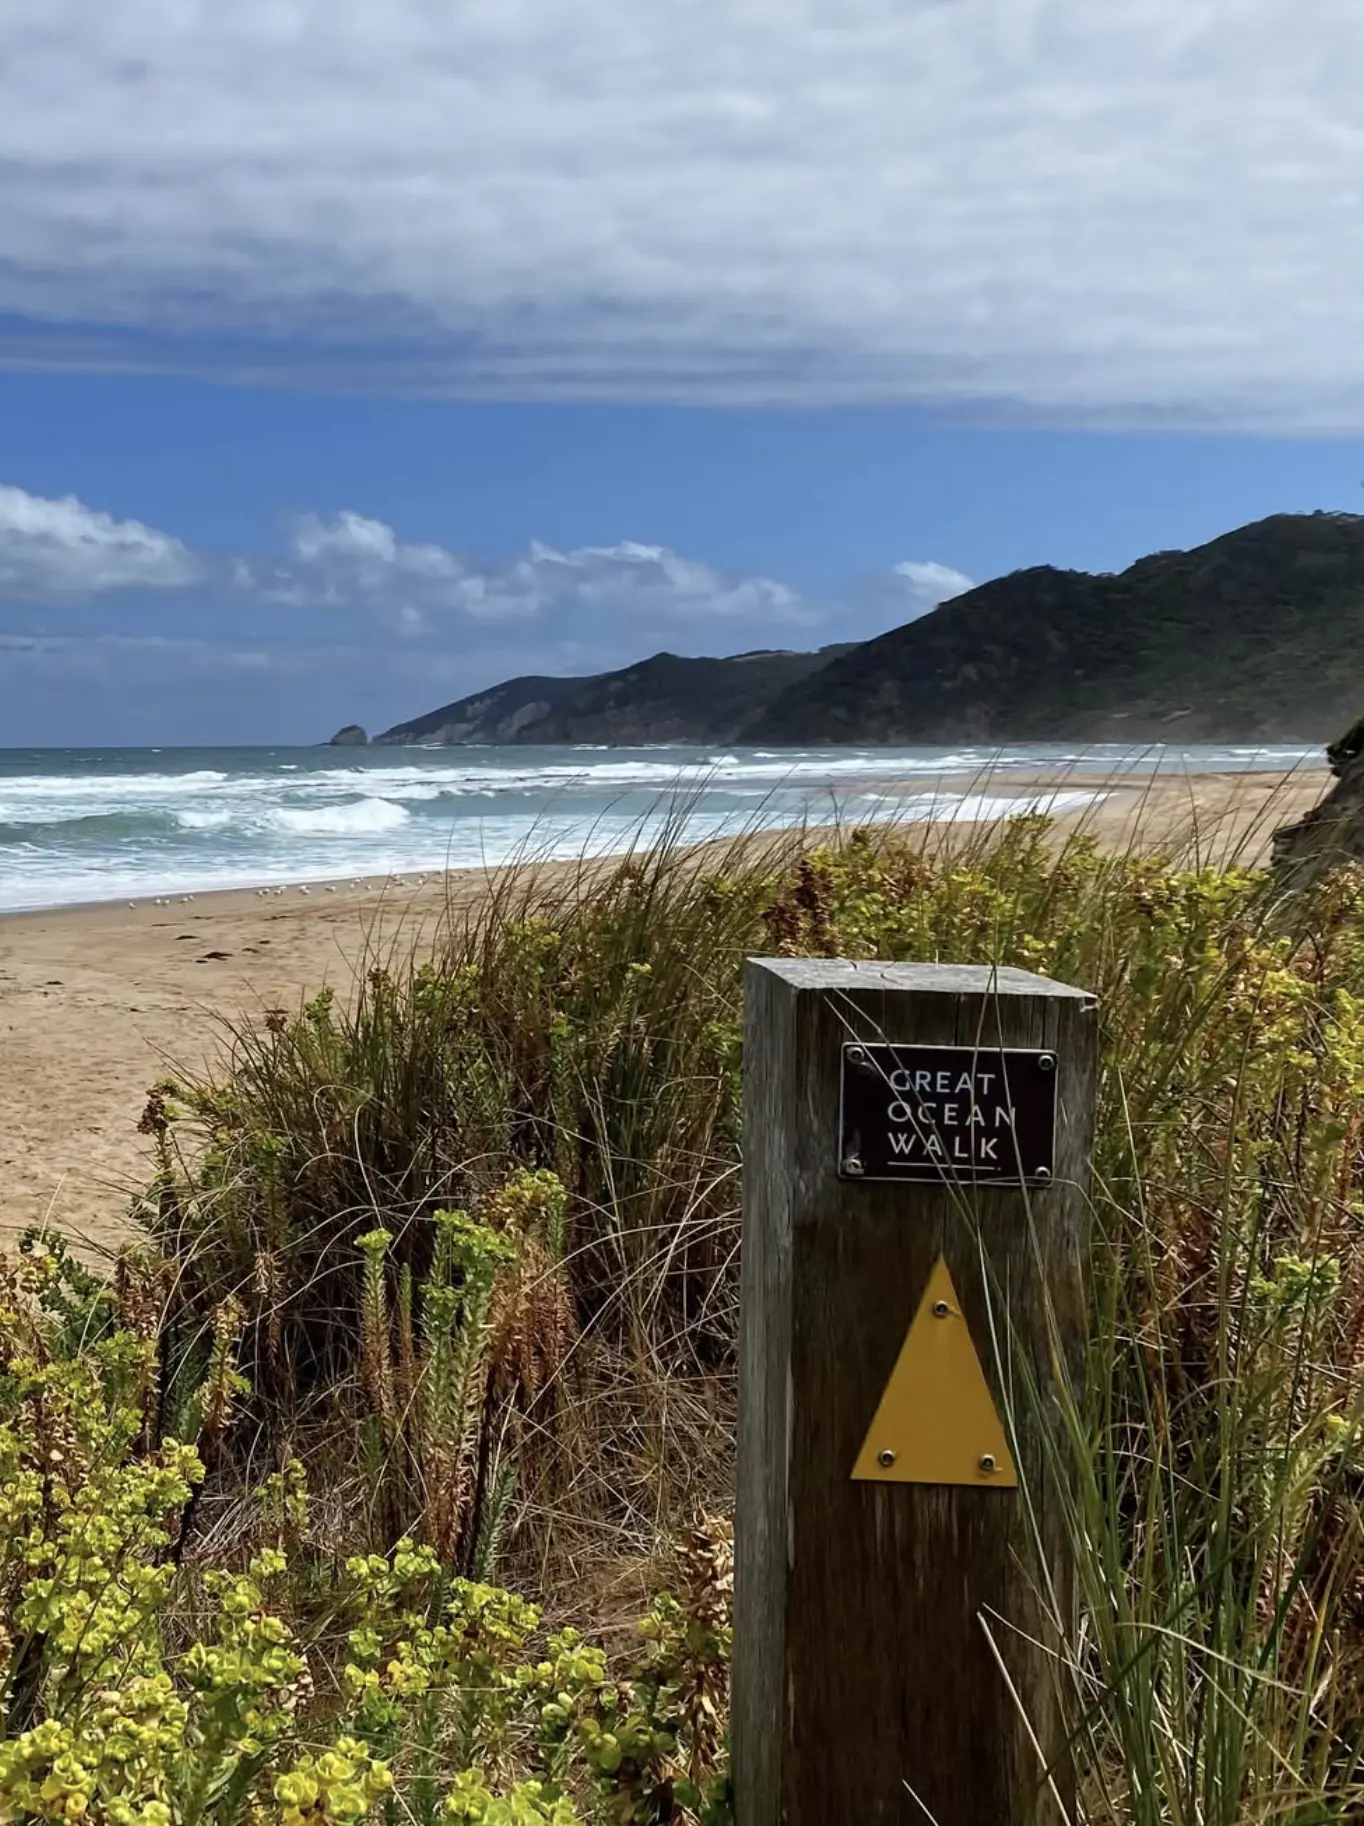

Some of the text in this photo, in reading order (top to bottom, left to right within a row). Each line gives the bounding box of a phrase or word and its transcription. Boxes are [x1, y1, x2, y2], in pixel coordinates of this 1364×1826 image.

[890, 1069, 996, 1095] GREAT
[887, 1101, 1016, 1127] OCEAN
[887, 1132, 999, 1160] WALK
